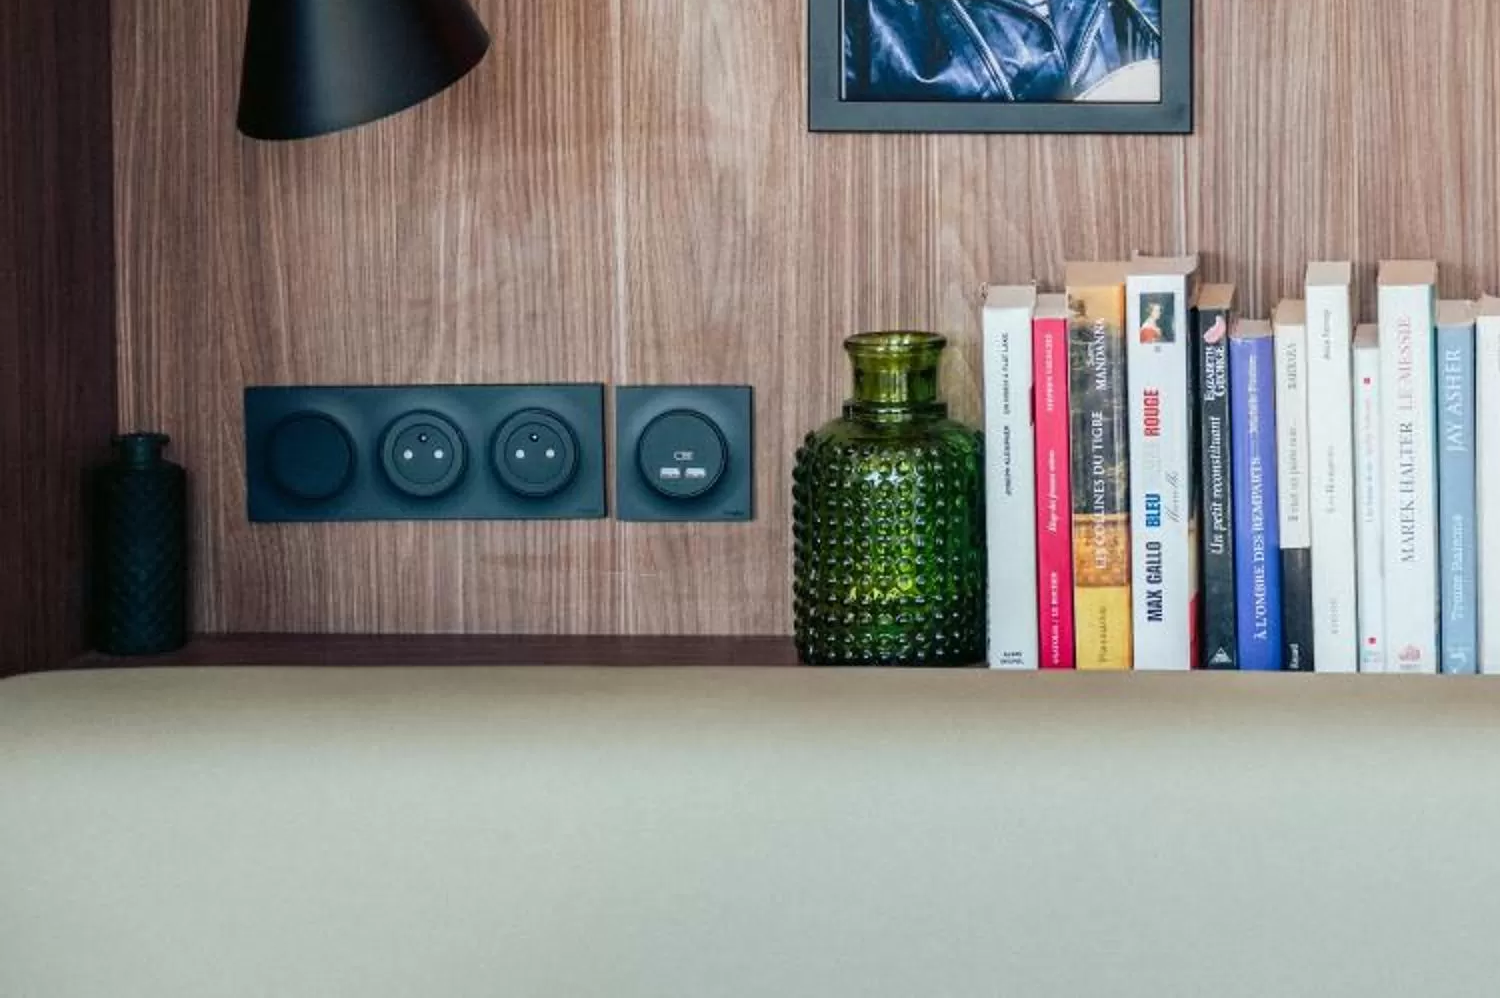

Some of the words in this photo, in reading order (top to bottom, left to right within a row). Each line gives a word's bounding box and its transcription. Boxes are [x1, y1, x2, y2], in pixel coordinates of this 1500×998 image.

[1397, 316, 1412, 379] MESSIE
[1213, 345, 1226, 397] GEORGE
[1445, 348, 1463, 417] ASHER
[1143, 388, 1161, 437] ROUGE
[1398, 384, 1413, 410] LE
[1091, 411, 1104, 451] TIGRE
[1446, 422, 1468, 452] JAY
[1092, 453, 1104, 475] DU
[1399, 422, 1415, 495] HALTER
[1093, 478, 1106, 545] COLLINES
[1144, 492, 1161, 528] BLEU
[1250, 458, 1263, 532] REMPARTS
[1208, 502, 1226, 532] petit
[1400, 500, 1415, 562] MAREK
[1094, 547, 1107, 569] LES
[1144, 541, 1162, 585] GALLO
[1210, 535, 1224, 555] Un
[1252, 534, 1265, 563] DES
[1146, 589, 1163, 622] MAX
[1252, 565, 1266, 627] L'OMBRE
